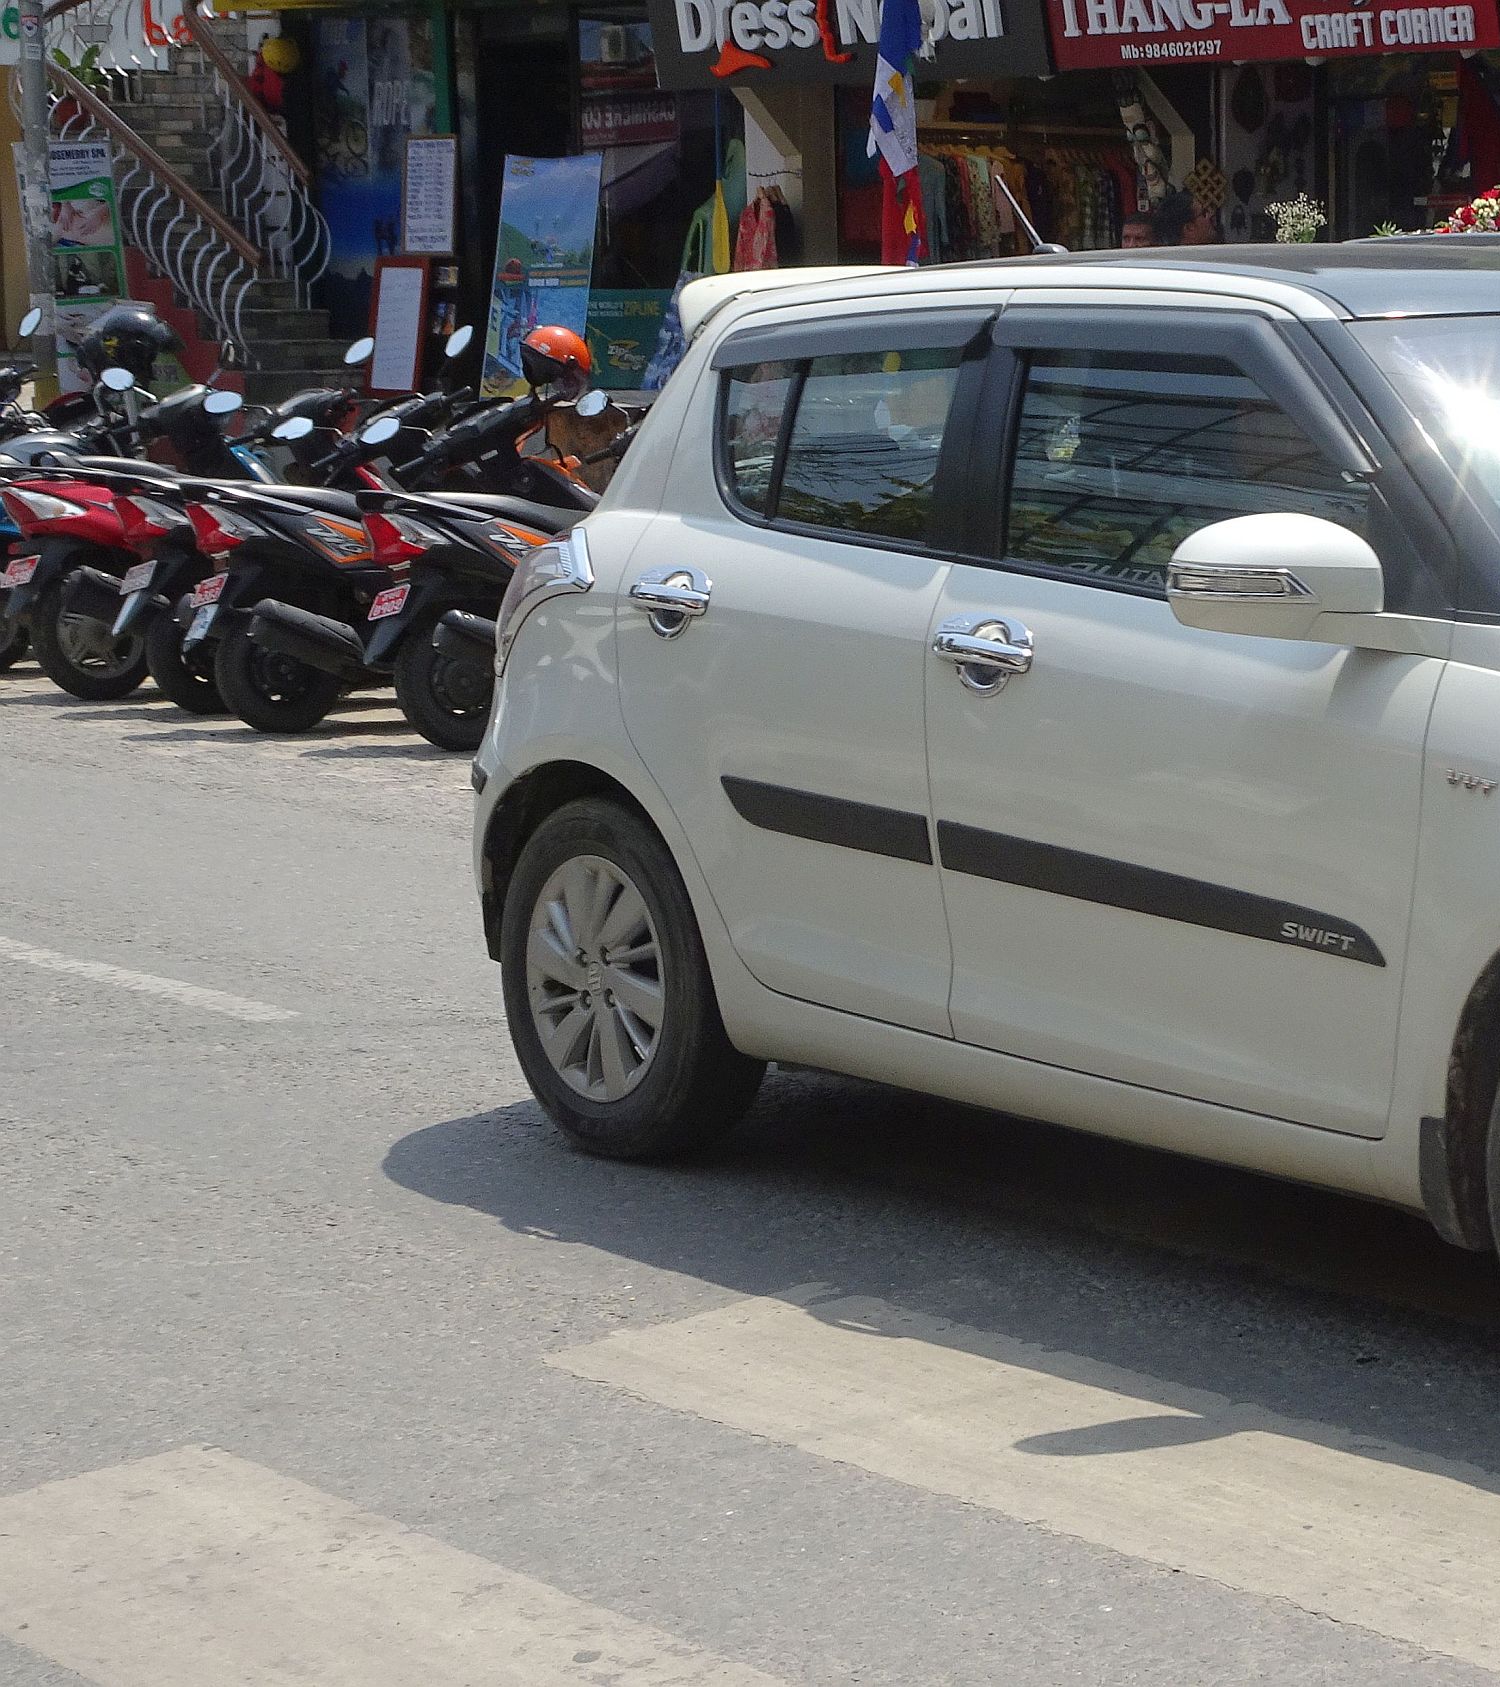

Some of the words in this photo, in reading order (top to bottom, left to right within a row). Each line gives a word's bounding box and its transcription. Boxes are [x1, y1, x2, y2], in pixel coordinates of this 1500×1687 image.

[678, 0, 817, 52] Dress
[837, 0, 1004, 45] Npal
[1301, 12, 1374, 49] CRAFT
[1380, 5, 1476, 45] CORNER
[1280, 920, 1356, 951] SWIFT
